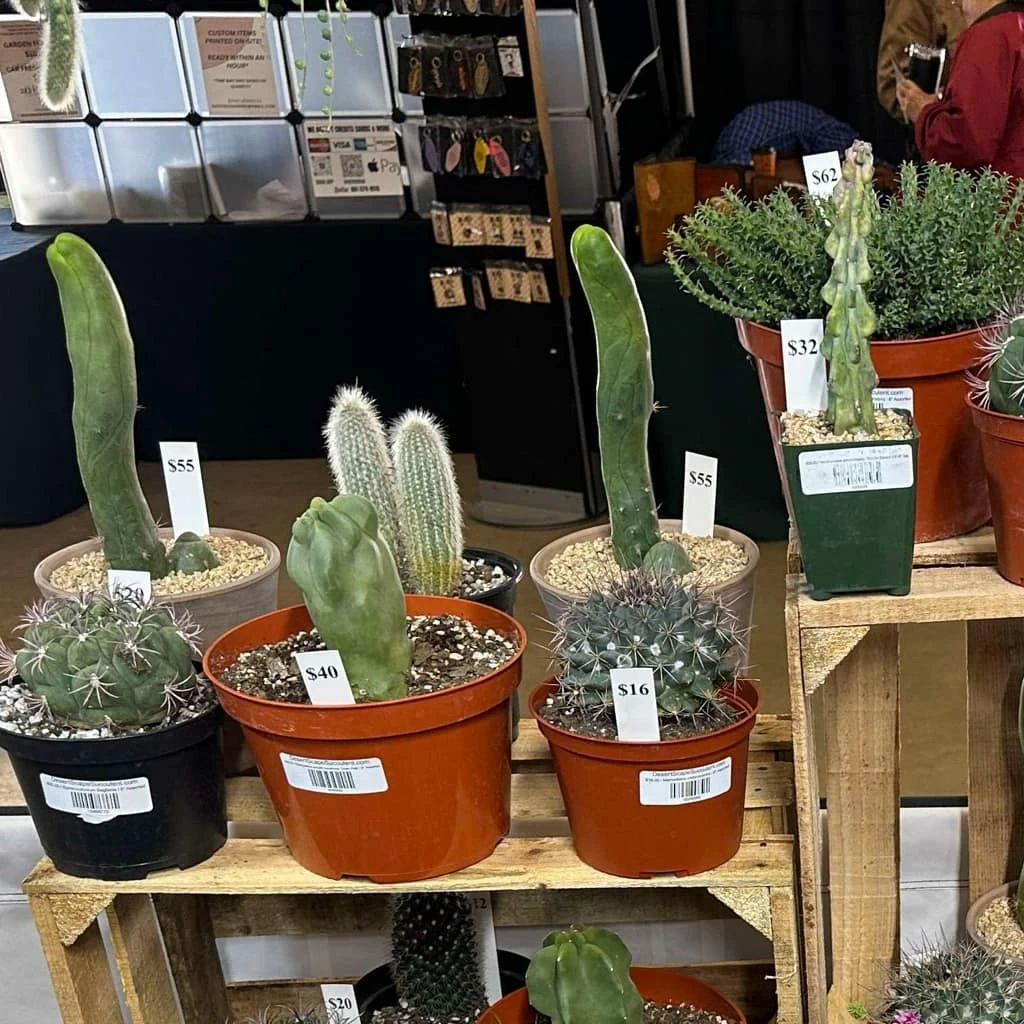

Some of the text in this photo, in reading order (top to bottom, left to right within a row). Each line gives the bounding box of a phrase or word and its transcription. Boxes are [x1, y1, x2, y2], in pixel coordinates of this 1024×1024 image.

[332, 141, 351, 149] VISA
[380, 158, 400, 176] Pay
[811, 167, 839, 186] $62
[787, 339, 818, 358] $32
[167, 458, 195, 473] $55
[688, 470, 713, 488] $55
[305, 664, 339, 682] $40
[617, 682, 650, 699] $16
[328, 997, 352, 1012] $20
